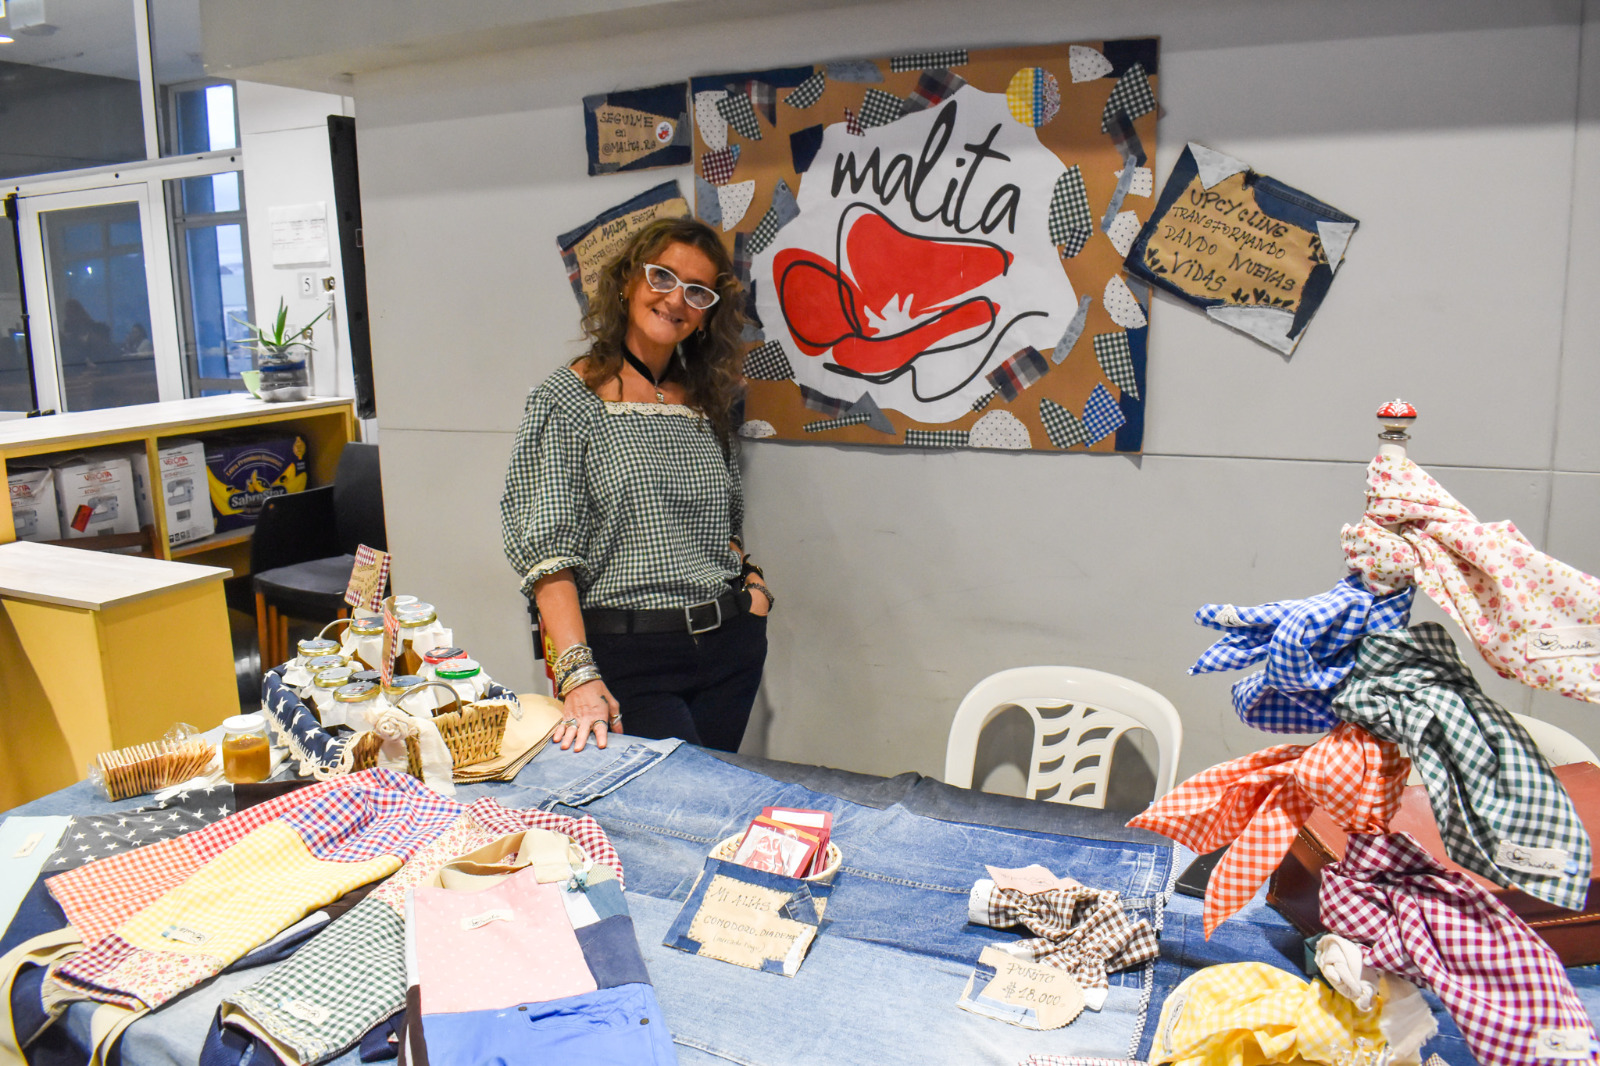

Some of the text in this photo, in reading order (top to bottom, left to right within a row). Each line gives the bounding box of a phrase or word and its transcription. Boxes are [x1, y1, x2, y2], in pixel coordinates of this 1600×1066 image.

[831, 100, 1021, 234] malita
[1172, 206, 1286, 259] TRANSFORMANDO
[1190, 189, 1288, 238] UPCYCLING
[304, 277, 311, 292] 5
[1165, 225, 1296, 291] DANDO NUEVAS
